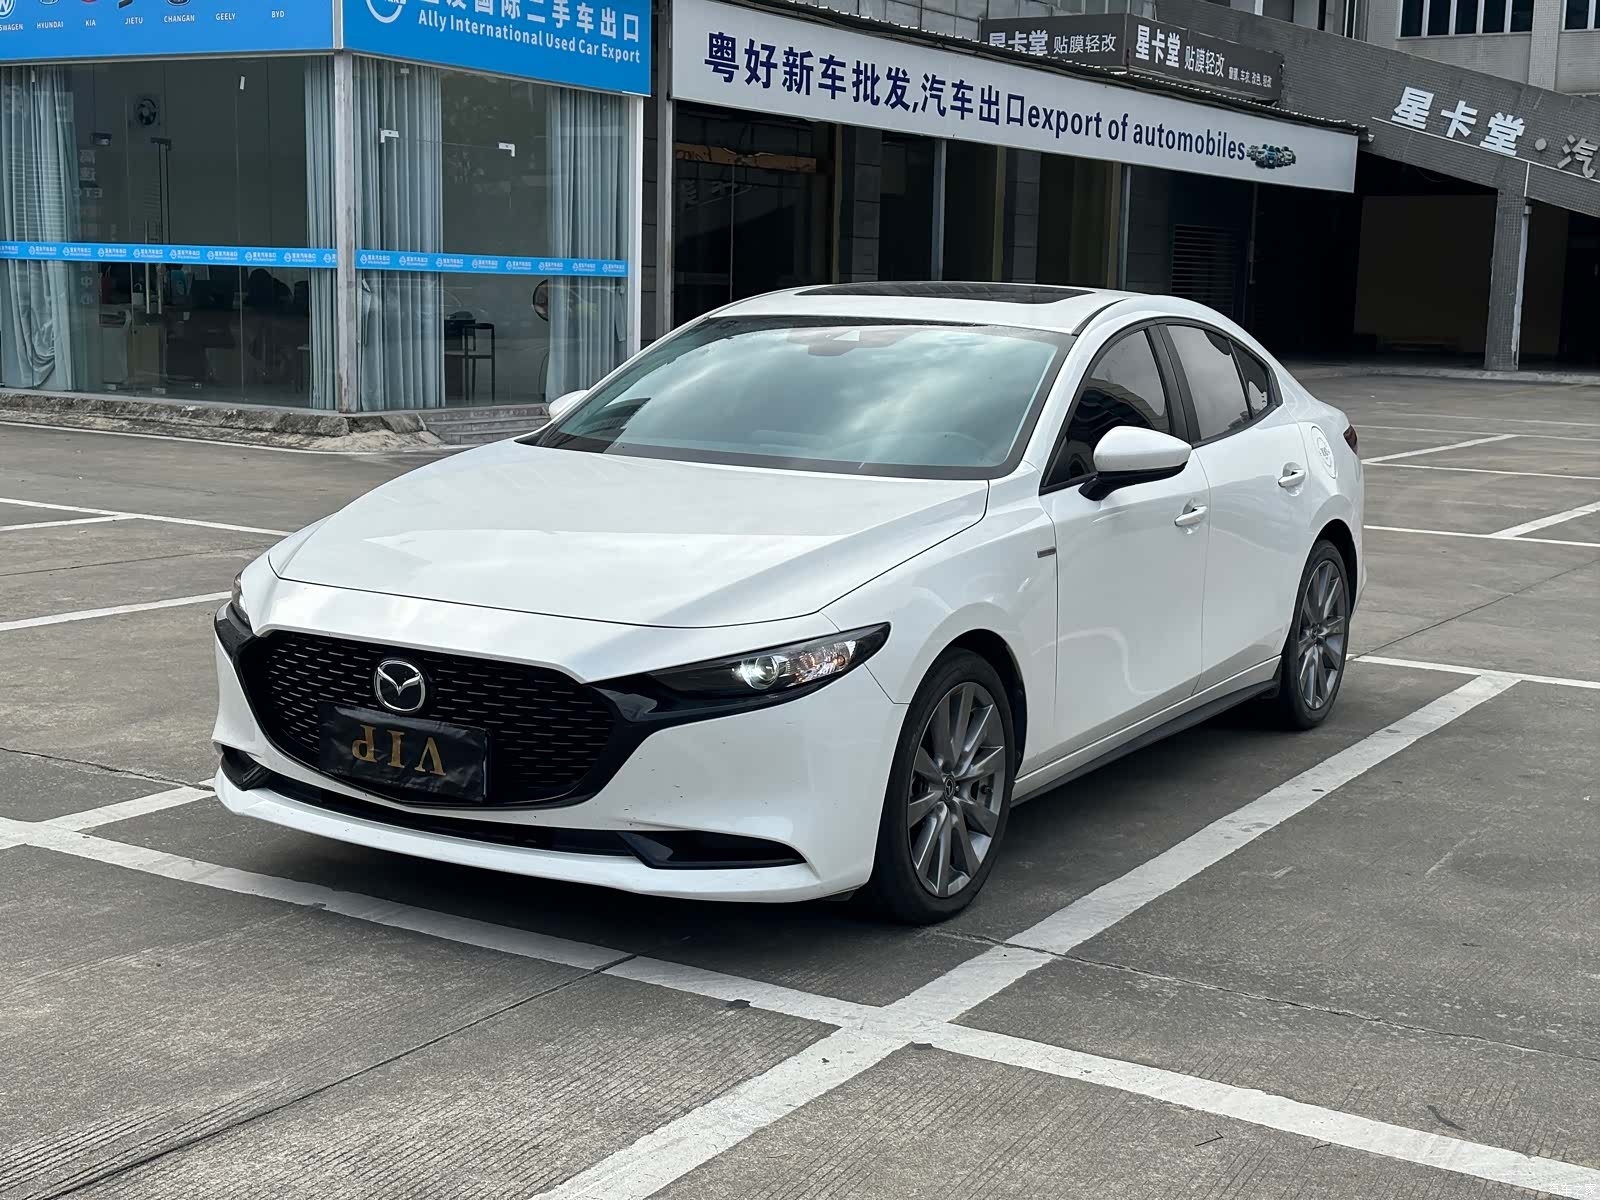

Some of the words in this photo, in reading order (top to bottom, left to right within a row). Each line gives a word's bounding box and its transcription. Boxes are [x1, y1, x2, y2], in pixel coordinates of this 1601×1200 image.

[124, 16, 143, 26] JIETU
[163, 14, 195, 24] CHANGAN
[215, 12, 236, 22] GEELY
[271, 10, 285, 19] BYD
[423, 0, 639, 42] 国际二手车出口
[36, 20, 64, 30] HYUNDAI
[85, 19, 96, 28] KIA
[418, 9, 447, 32] Ally
[450, 14, 543, 46] International
[545, 32, 576, 52] Used
[578, 39, 599, 56] Car
[601, 43, 641, 64] Export
[1052, 33, 1117, 54] 贴膜轻改
[1135, 24, 1181, 68] 星卡堂
[1183, 44, 1225, 77] 贴膜轻改
[704, 32, 1025, 126] 粤好新车批发,汽车出口
[1027, 104, 1102, 139] export
[1107, 113, 1129, 141] of
[1132, 122, 1246, 161] automobiles
[1391, 86, 1525, 157] 星卡堂
[1556, 134, 1599, 179] 汽
